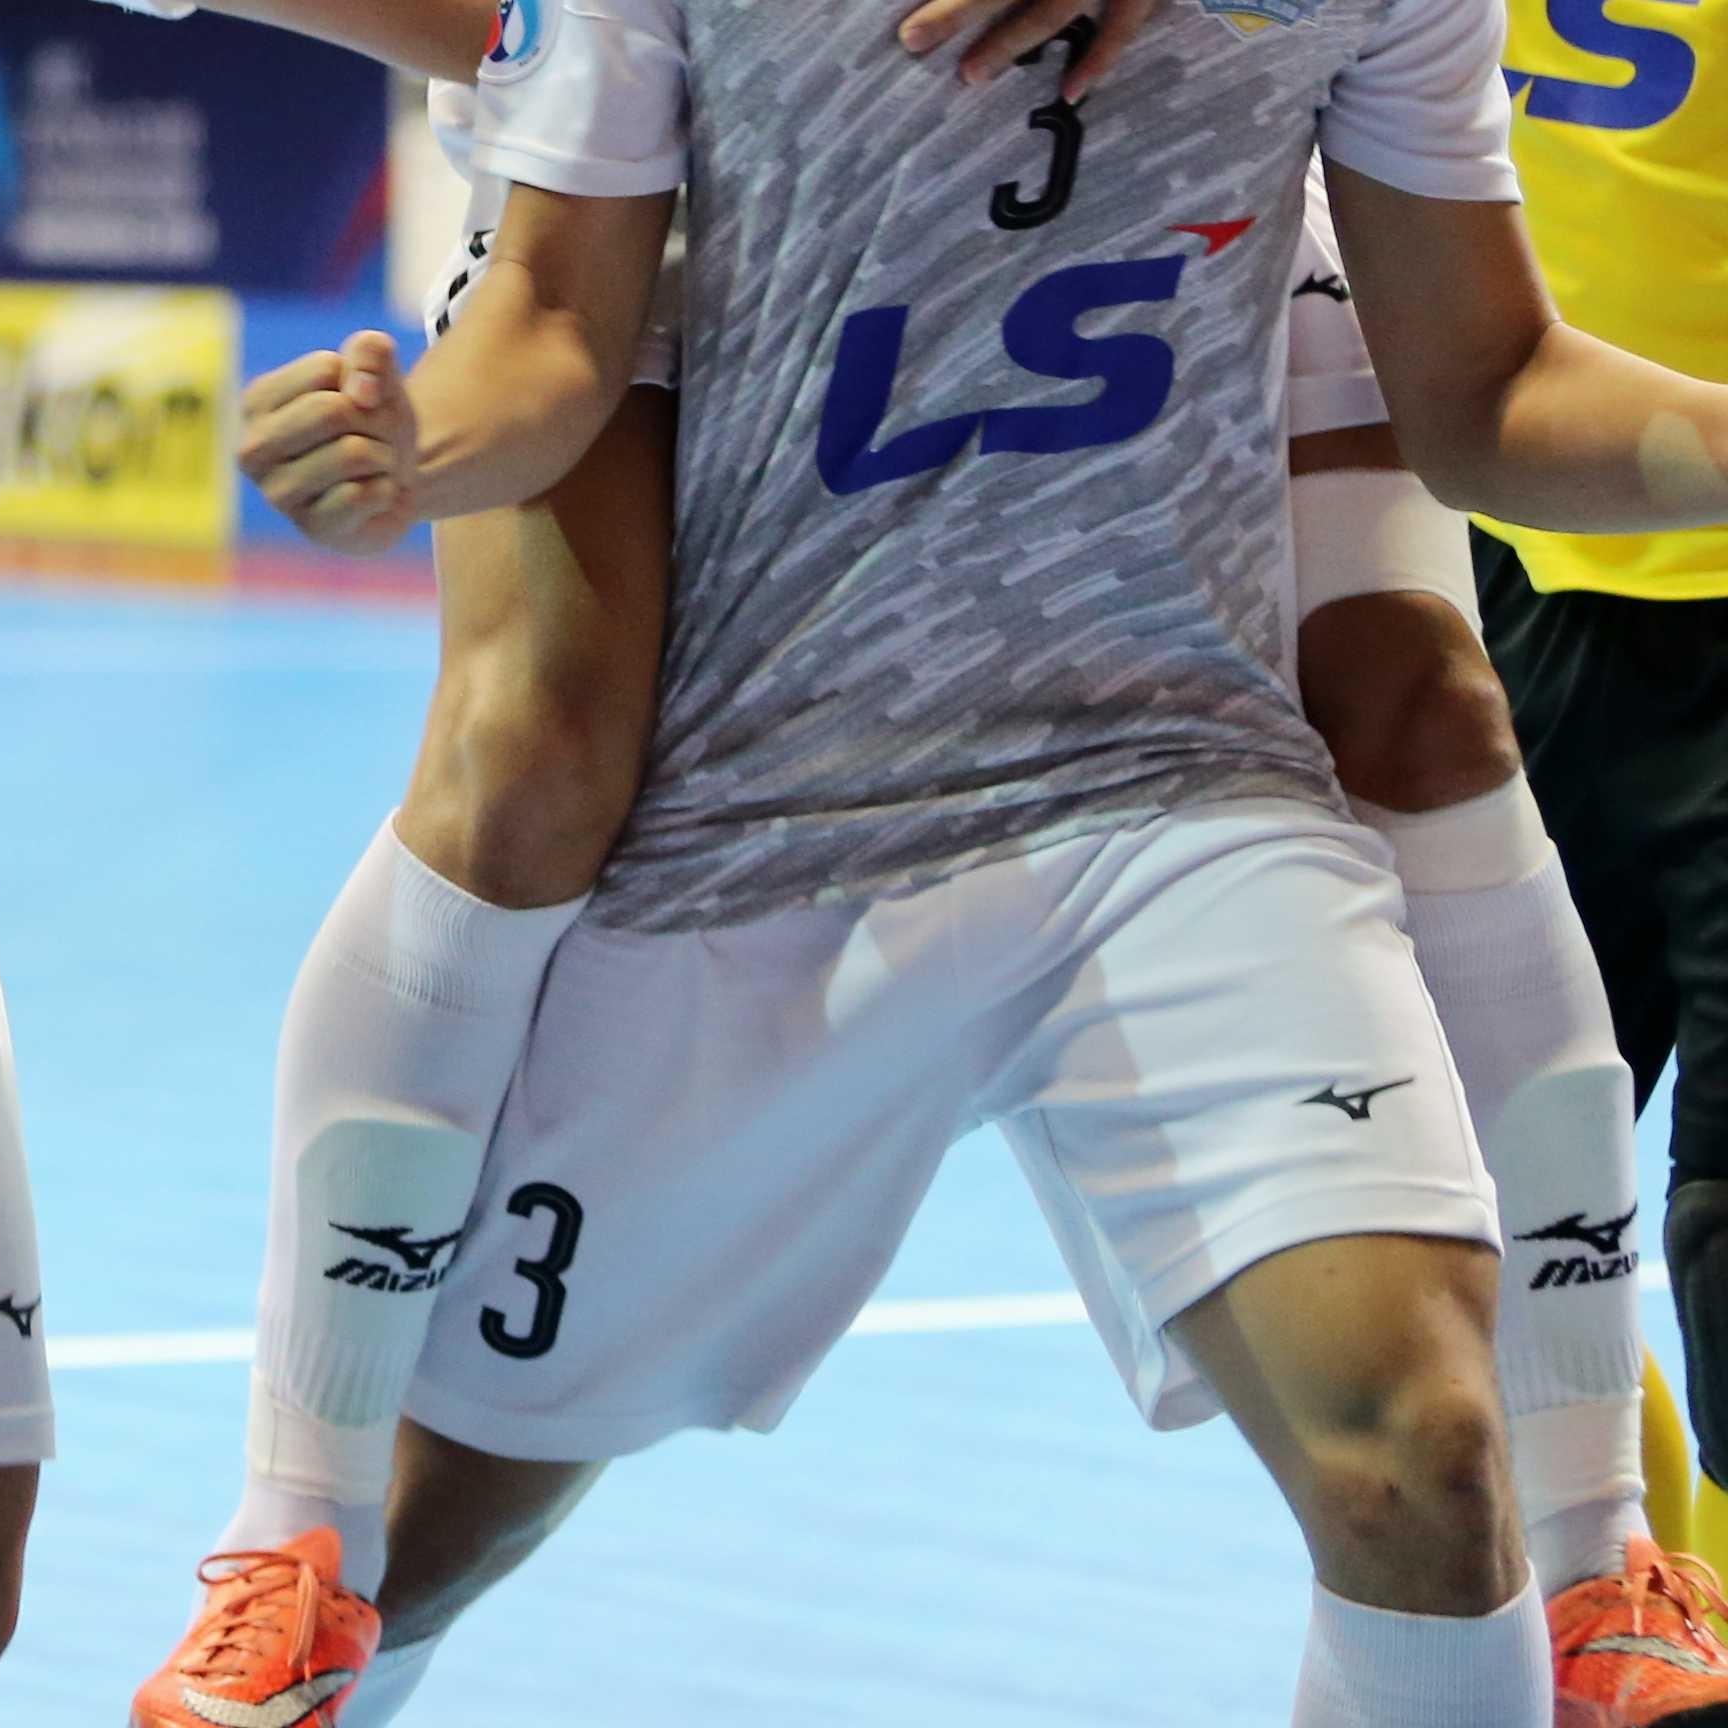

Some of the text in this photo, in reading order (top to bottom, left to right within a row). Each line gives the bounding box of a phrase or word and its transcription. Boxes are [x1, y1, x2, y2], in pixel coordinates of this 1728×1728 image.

[989, 14, 1094, 231] 3
[815, 254, 1186, 497] LS
[479, 1181, 585, 1361] 3
